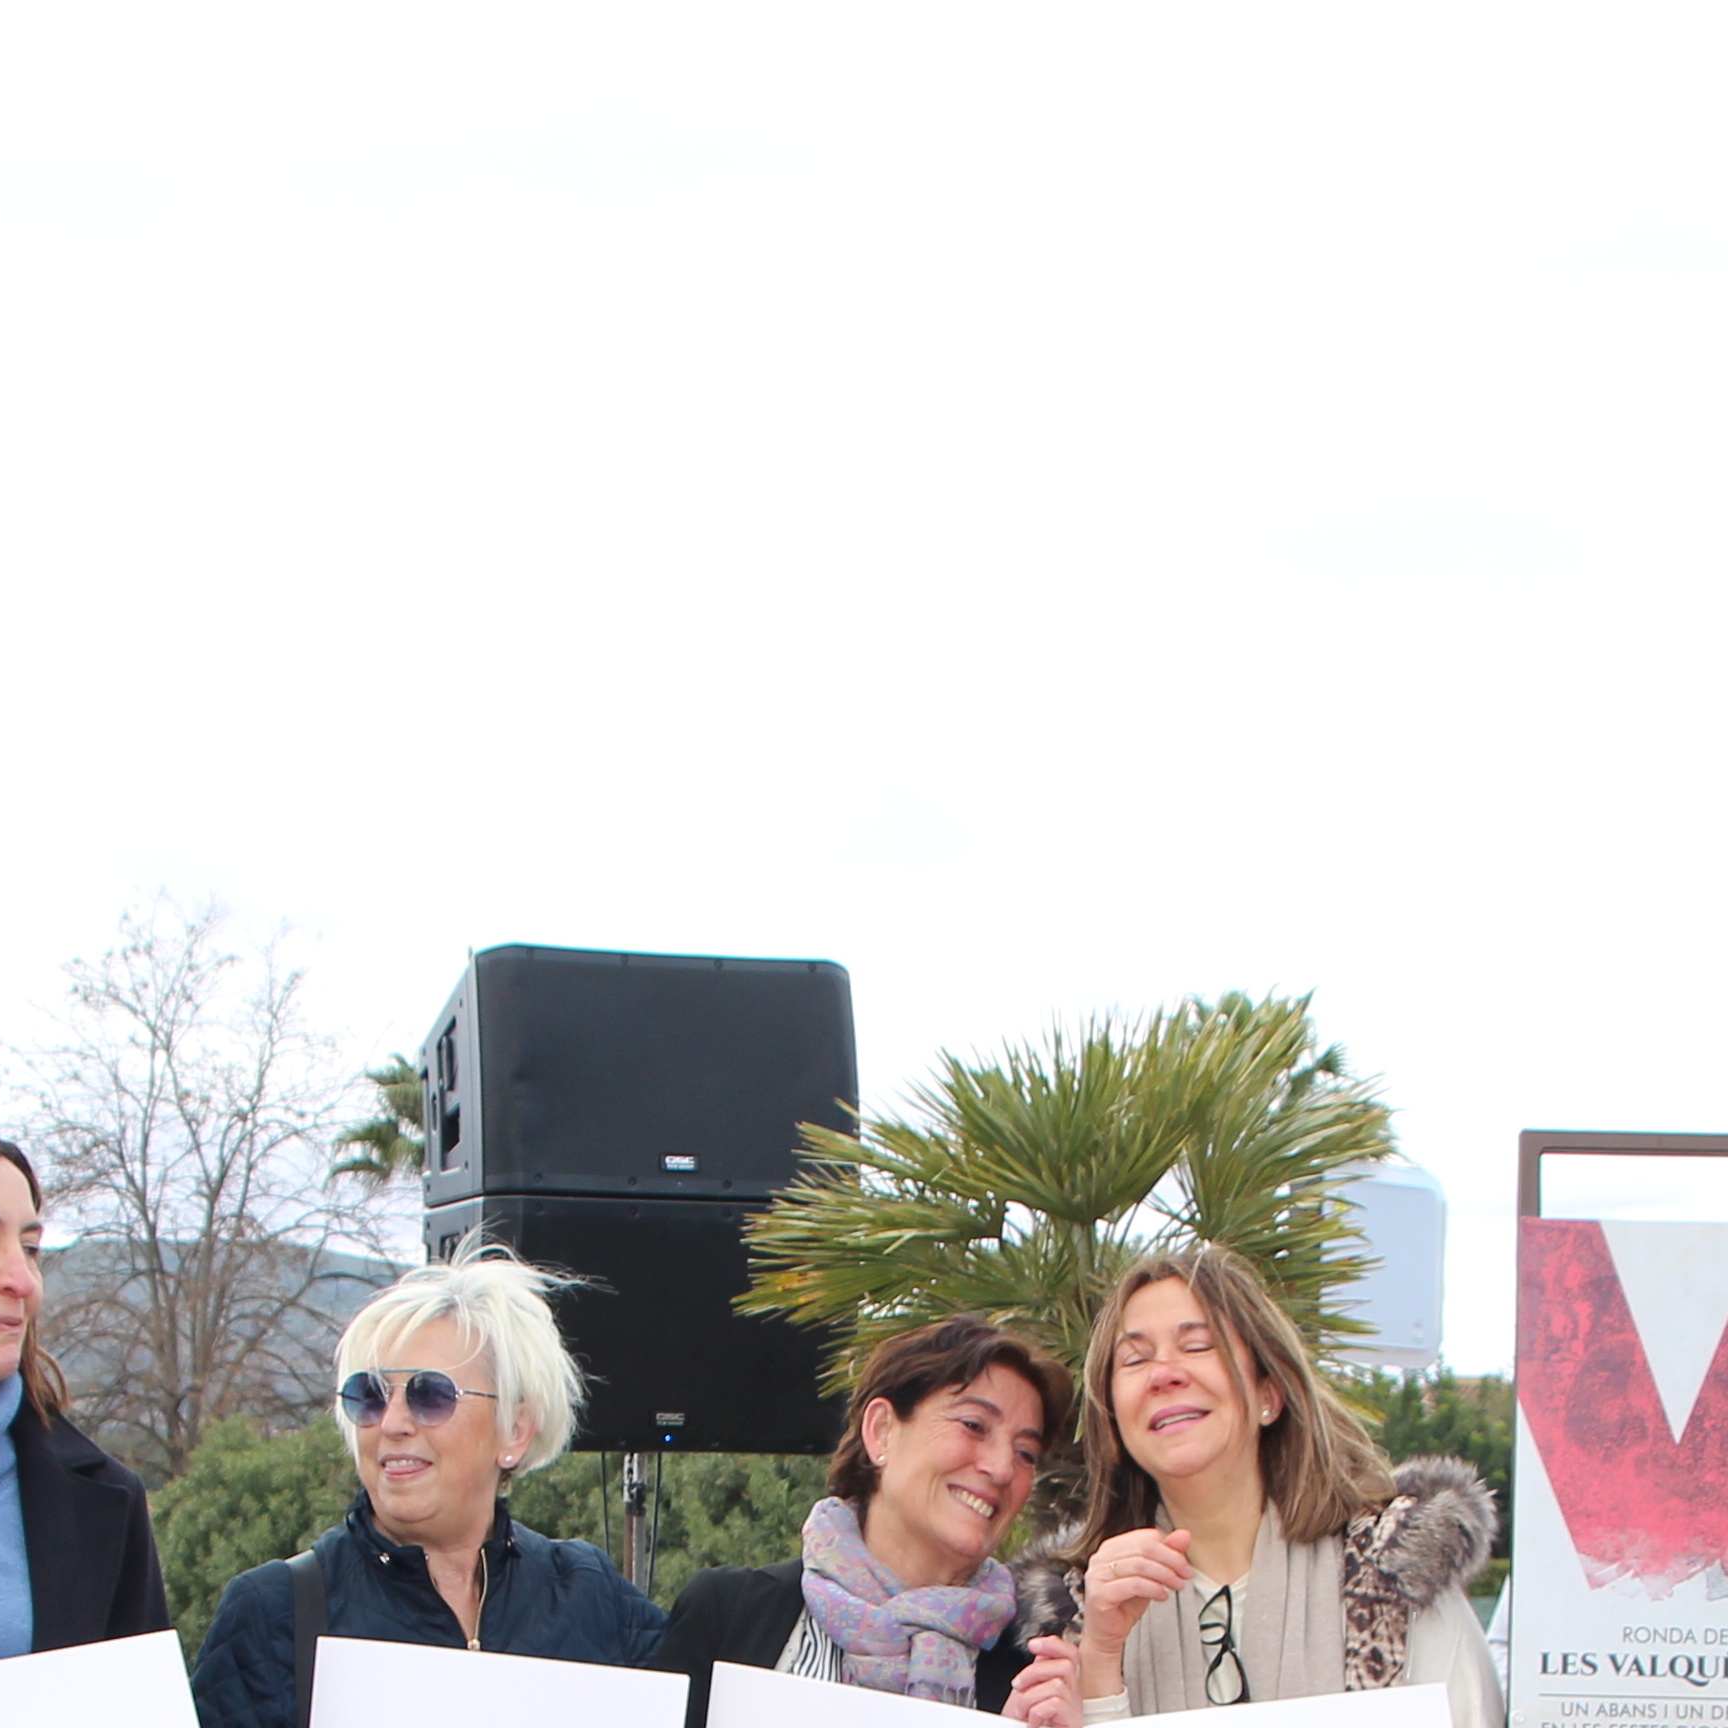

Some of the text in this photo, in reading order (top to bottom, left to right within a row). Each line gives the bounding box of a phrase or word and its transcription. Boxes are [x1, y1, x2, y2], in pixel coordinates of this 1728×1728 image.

[1623, 1626, 1696, 1646] RONDA
[1539, 1652, 1599, 1677] LES
[1561, 1702, 1589, 1717] UN
[1596, 1703, 1657, 1719] ABANS
[1664, 1704, 1668, 1719] I
[1676, 1705, 1704, 1720] UN
